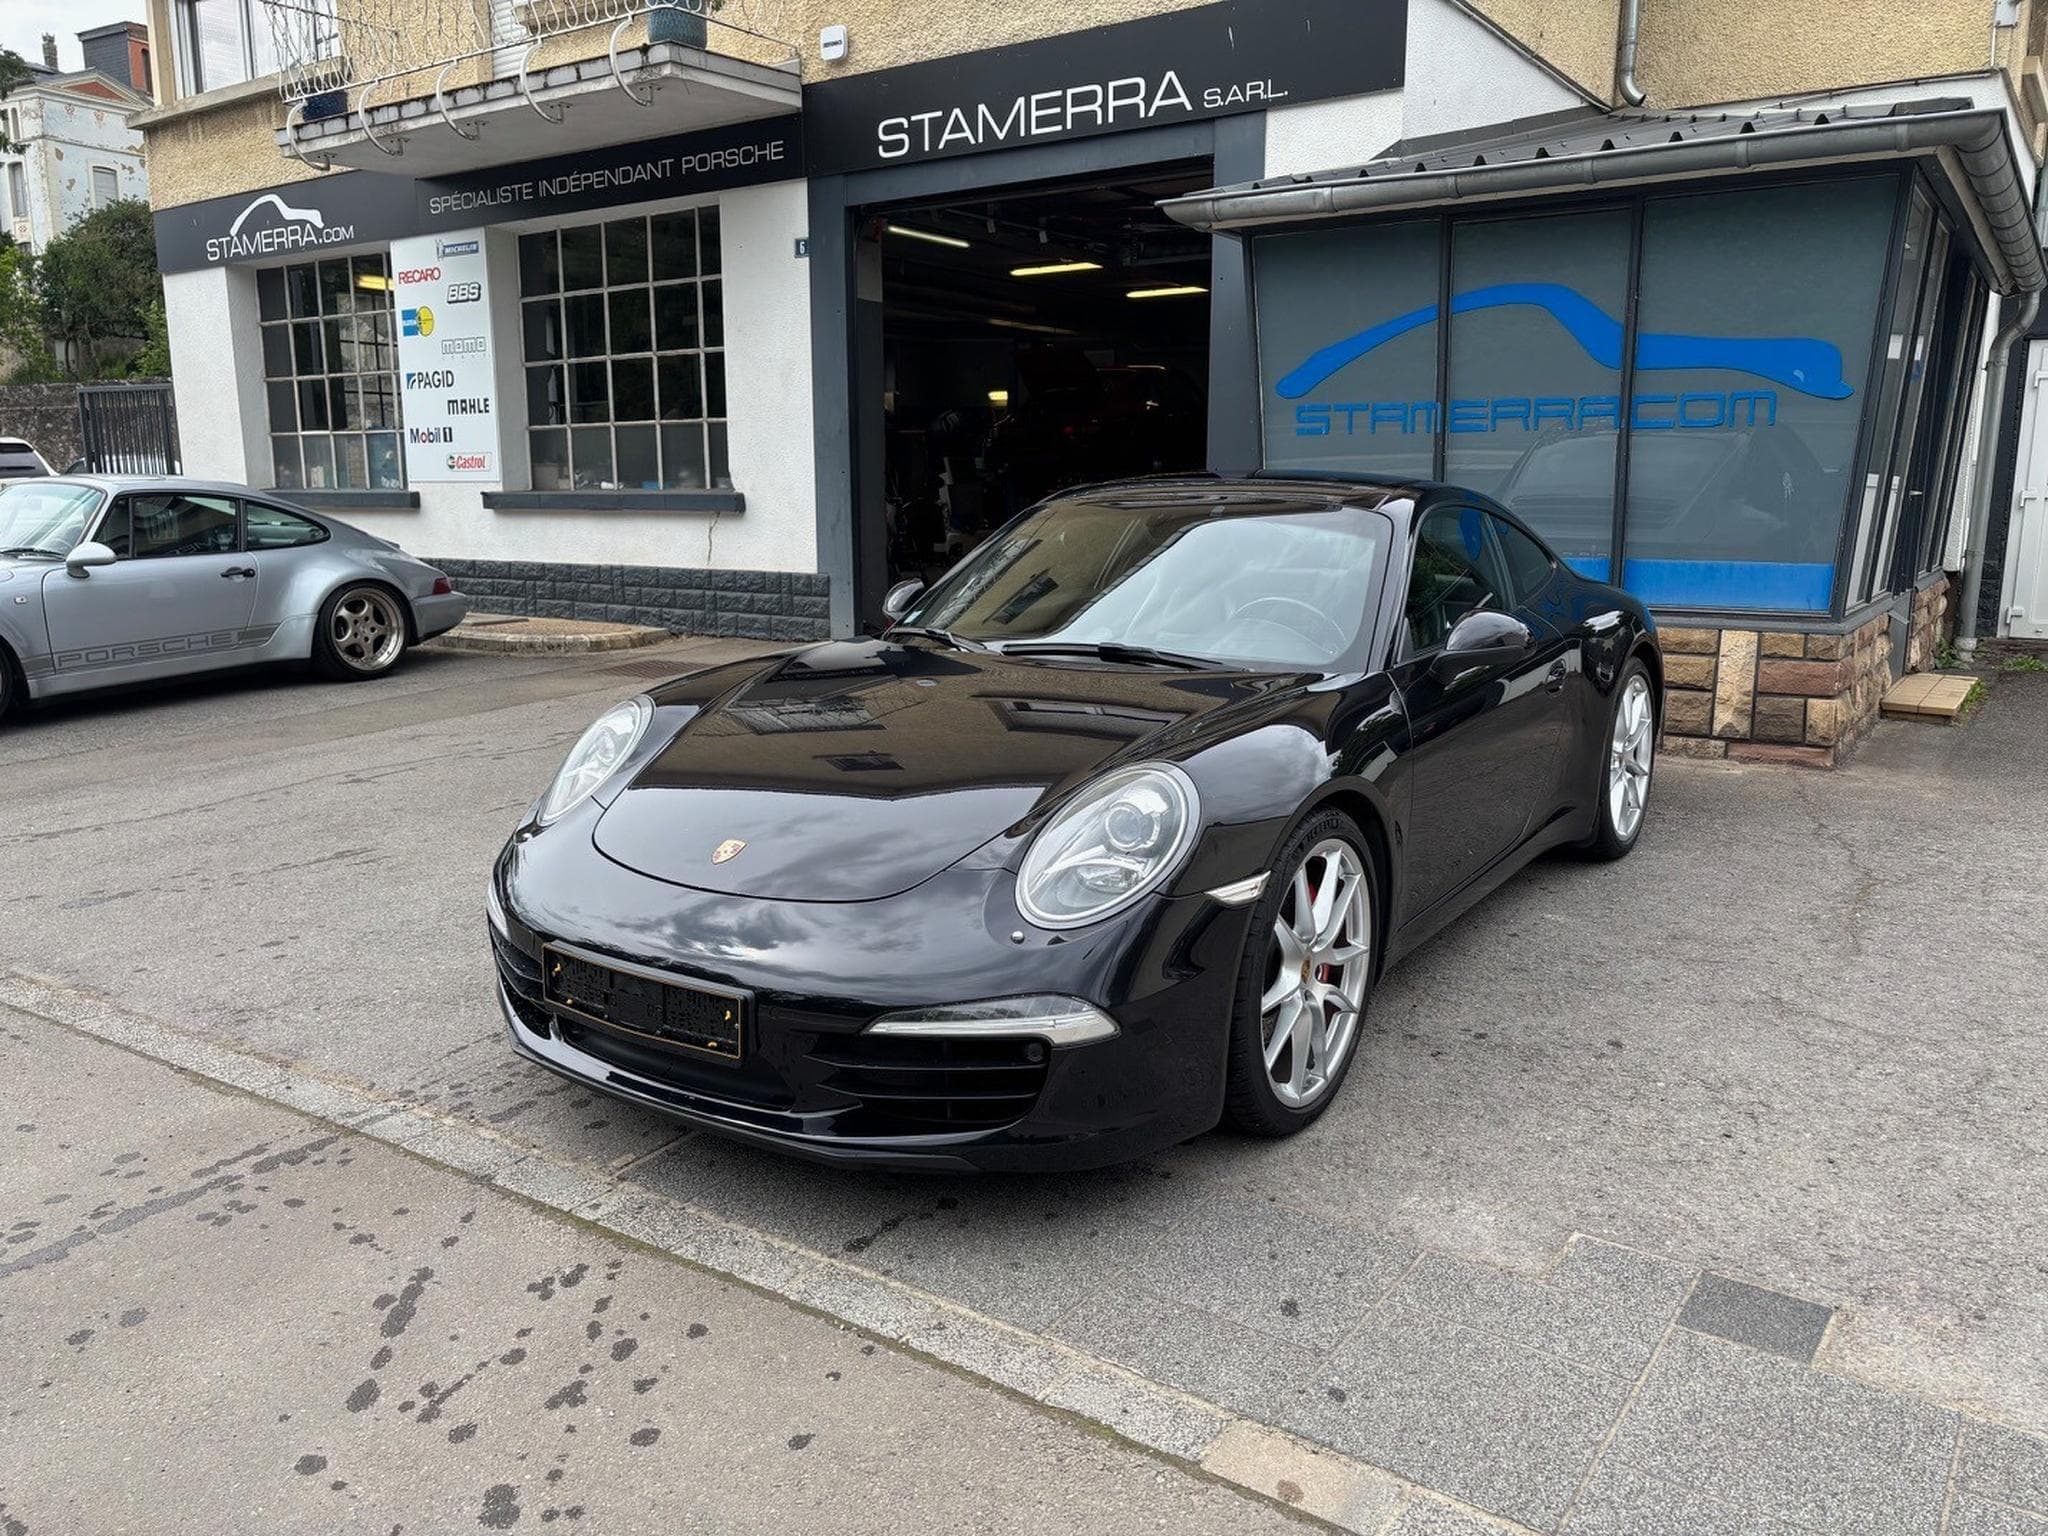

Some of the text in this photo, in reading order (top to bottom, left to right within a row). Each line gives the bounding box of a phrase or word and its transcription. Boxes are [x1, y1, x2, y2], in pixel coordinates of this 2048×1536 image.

[877, 70, 1193, 158] STAMERRA
[429, 140, 785, 216] SPÉCIALISTE INDÉPENDANT PORSCHE
[206, 223, 355, 261] STAMERRA.COM
[799, 241, 806, 254] 6
[398, 266, 441, 285] RECARO
[447, 281, 481, 304] BBS
[417, 369, 455, 390] PAGID
[447, 397, 490, 415] MAHLE
[409, 427, 441, 444] Mobil
[455, 455, 486, 469] Castrol
[58, 630, 232, 667] PORSCHE
